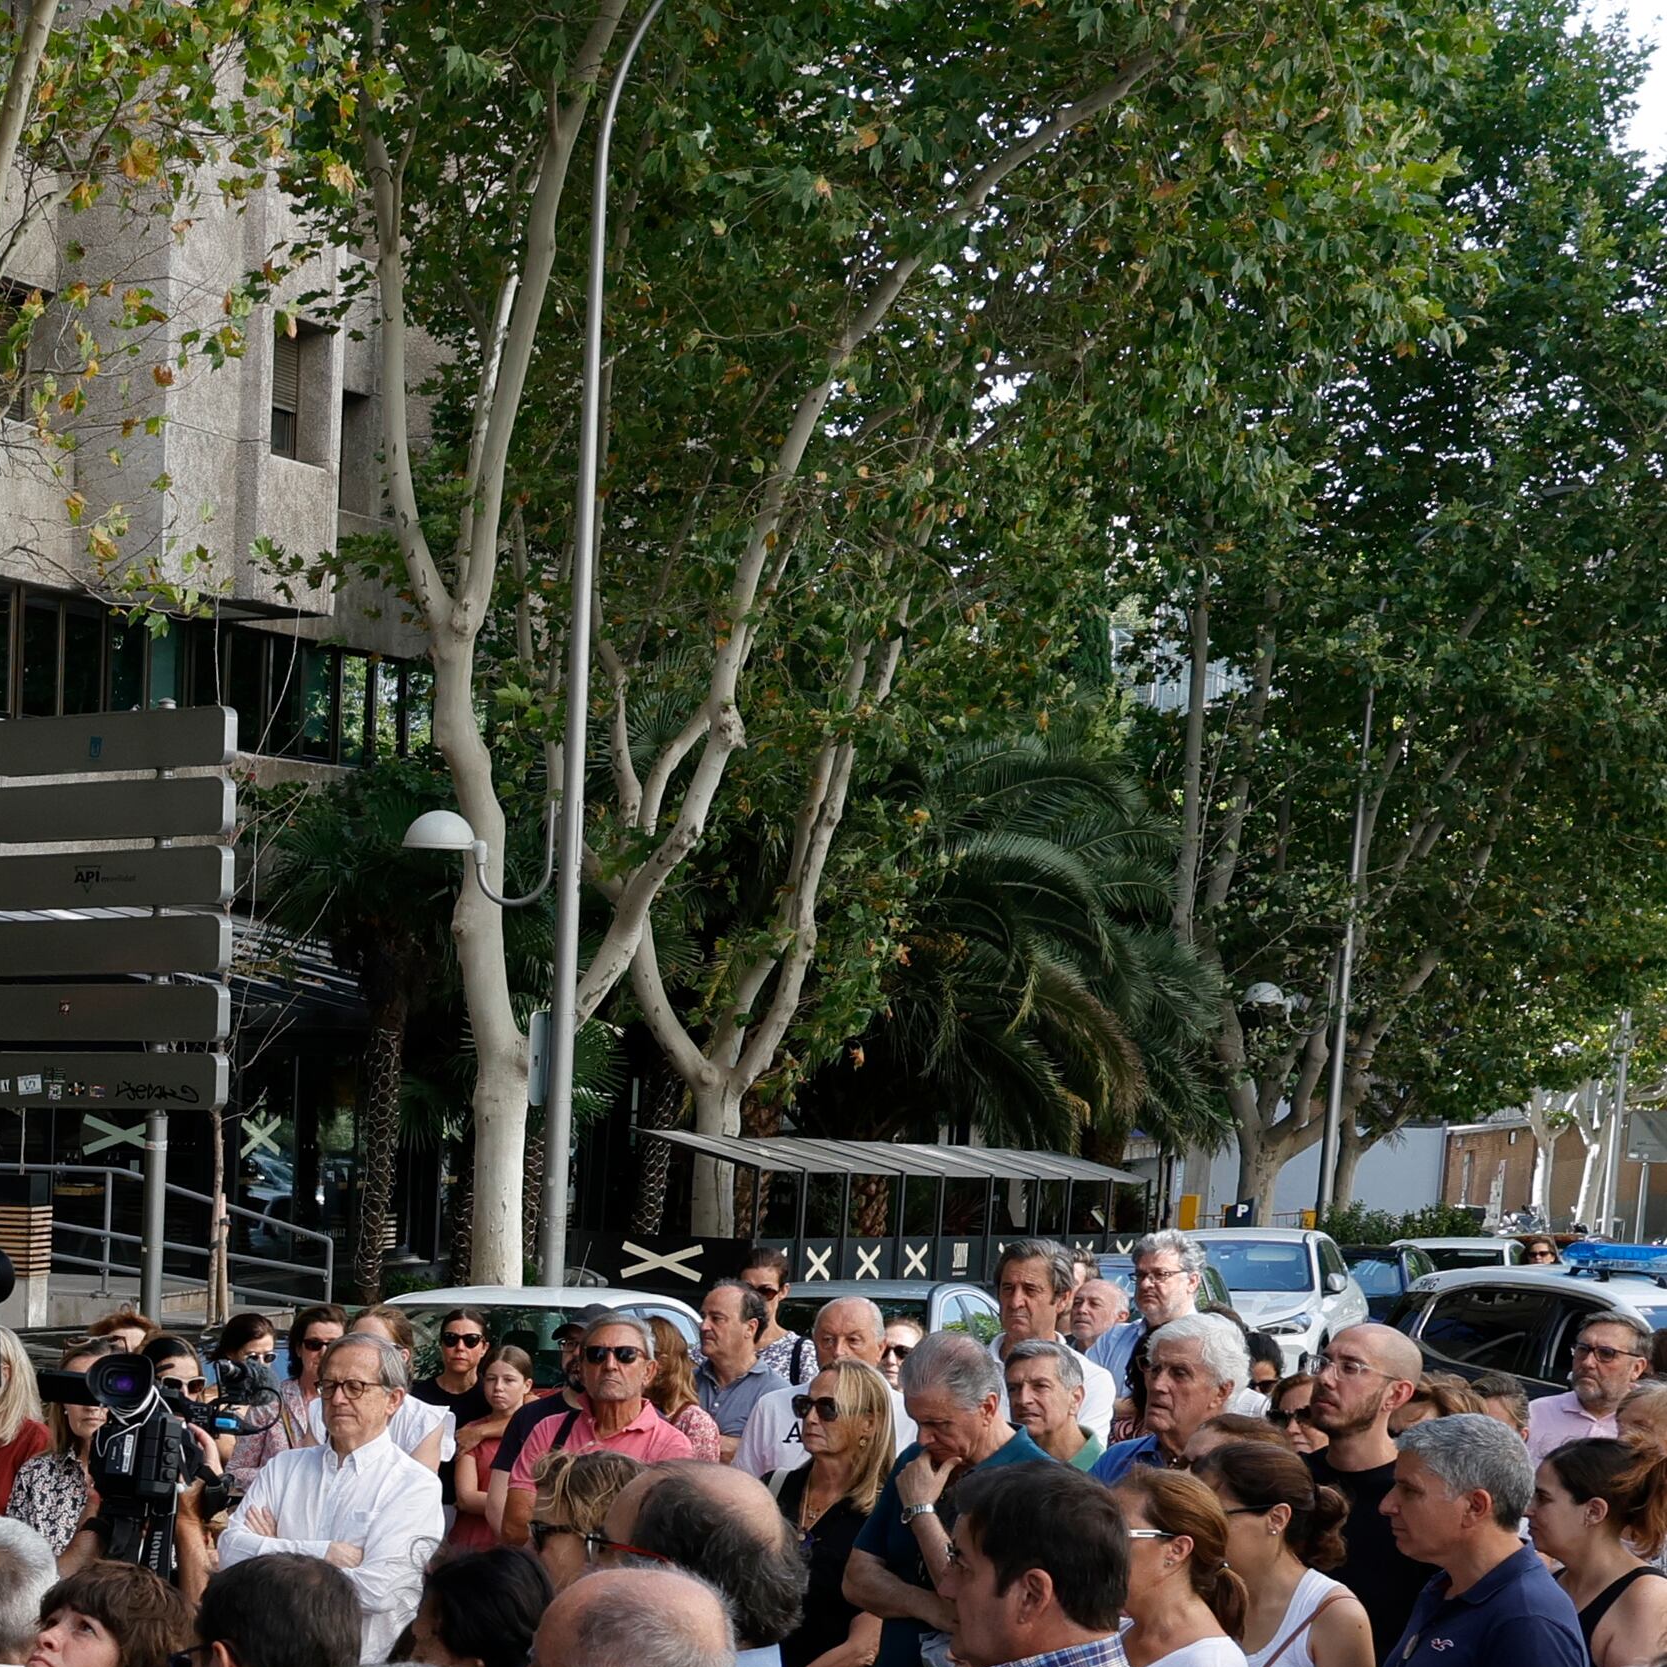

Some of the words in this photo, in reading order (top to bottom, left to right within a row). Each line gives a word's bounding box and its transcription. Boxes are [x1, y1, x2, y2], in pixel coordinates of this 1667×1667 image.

[74, 871, 101, 884] API
[1236, 1203, 1249, 1218] P
[148, 1531, 164, 1571] anon
